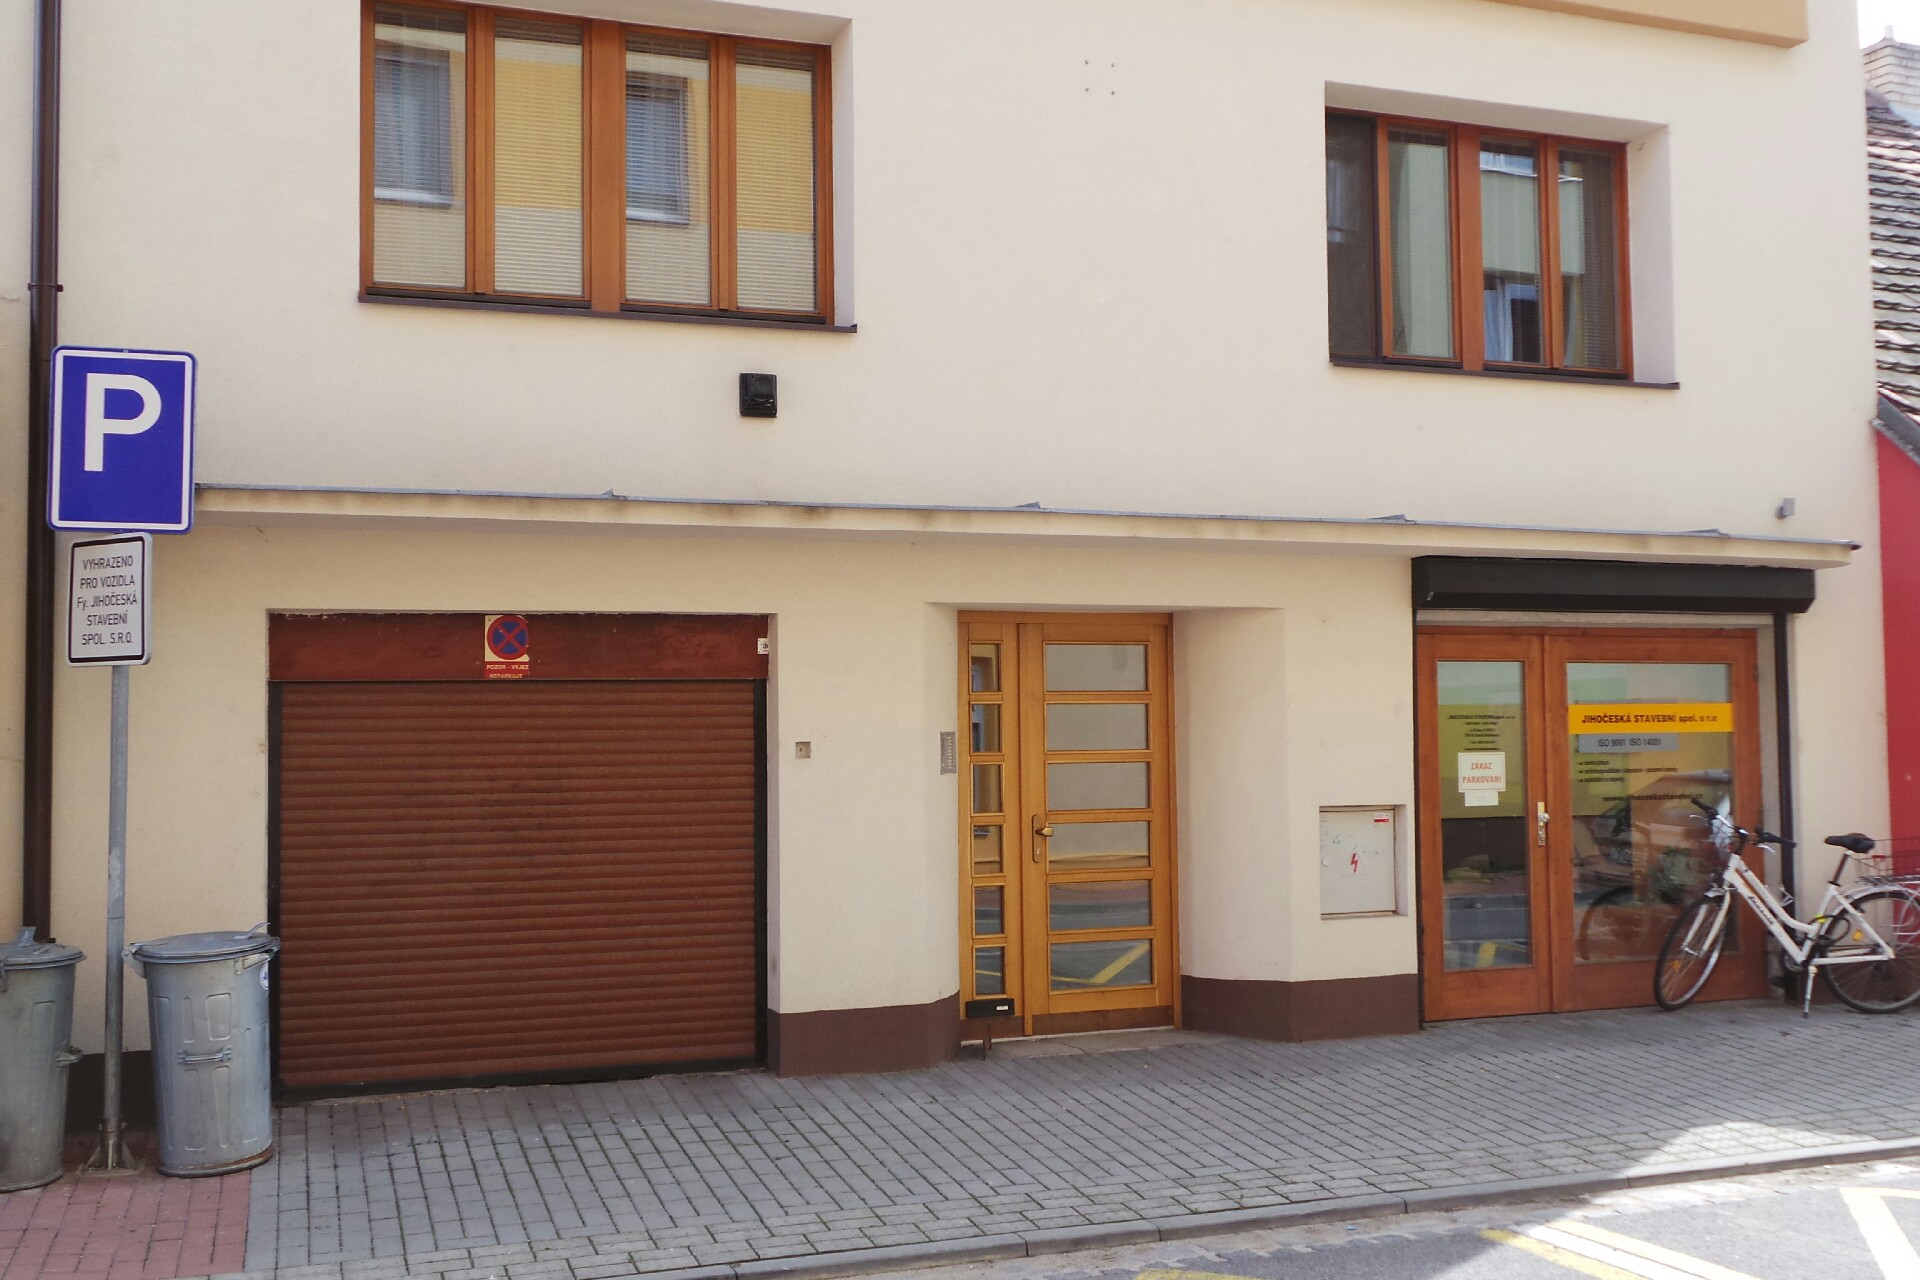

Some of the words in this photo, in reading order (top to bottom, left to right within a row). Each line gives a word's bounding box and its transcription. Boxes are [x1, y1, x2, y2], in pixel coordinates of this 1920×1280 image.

[84, 372, 162, 472] P
[82, 555, 134, 570] VYHRAZENO
[80, 577, 98, 589] PRO
[100, 574, 135, 588] VOZIDLA
[91, 590, 138, 608] JIHOČESKÁ
[86, 610, 128, 626] STAVEBNÍ
[110, 632, 133, 644] S.R.O.
[1582, 712, 1632, 724] JIHOČESKÁ
[1634, 711, 1676, 723] STAVEBNÍ
[1597, 738, 1610, 748] ISO
[1611, 738, 1626, 747] 9001
[1629, 738, 1641, 747] ISO
[1643, 737, 1661, 746] 14001
[1470, 761, 1493, 770] ZÁKAZ
